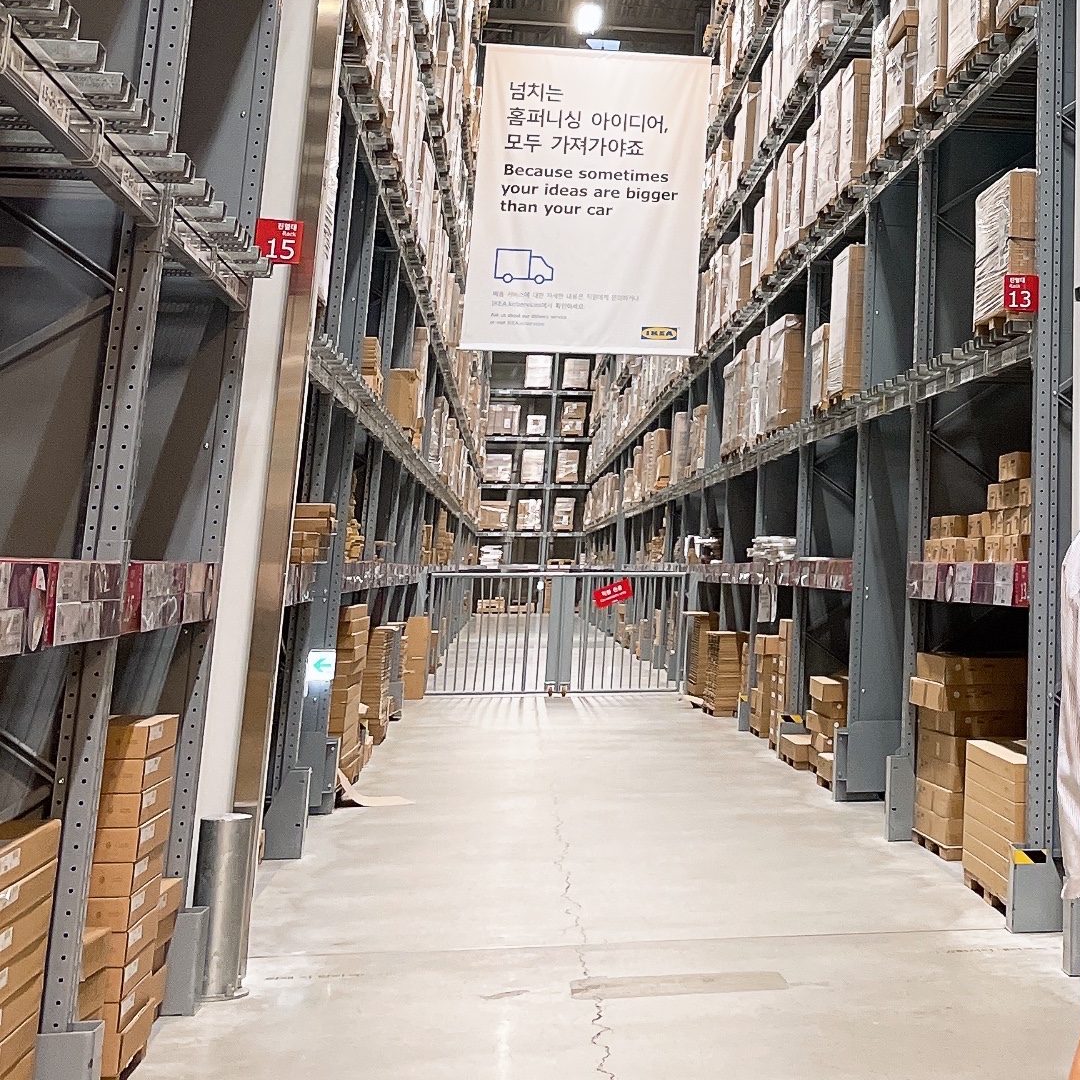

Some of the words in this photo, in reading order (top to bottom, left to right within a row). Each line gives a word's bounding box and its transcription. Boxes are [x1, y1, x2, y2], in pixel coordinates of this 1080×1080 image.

[509, 81, 564, 102] 넘치는
[507, 106, 582, 129] 홈퍼니싱
[591, 111, 668, 134] 아이디어,
[504, 133, 543, 153] 모두
[550, 135, 645, 157] 가져가야죠
[503, 163, 573, 179] Because
[578, 169, 669, 183] sometimes
[501, 184, 539, 197] your
[544, 183, 588, 197] ideas
[593, 187, 621, 198] are
[626, 187, 678, 202] bigger
[500, 200, 538, 213] than
[544, 204, 582, 217] your
[587, 205, 614, 216] car
[266, 237, 296, 260] 15
[1008, 290, 1032, 308] 13
